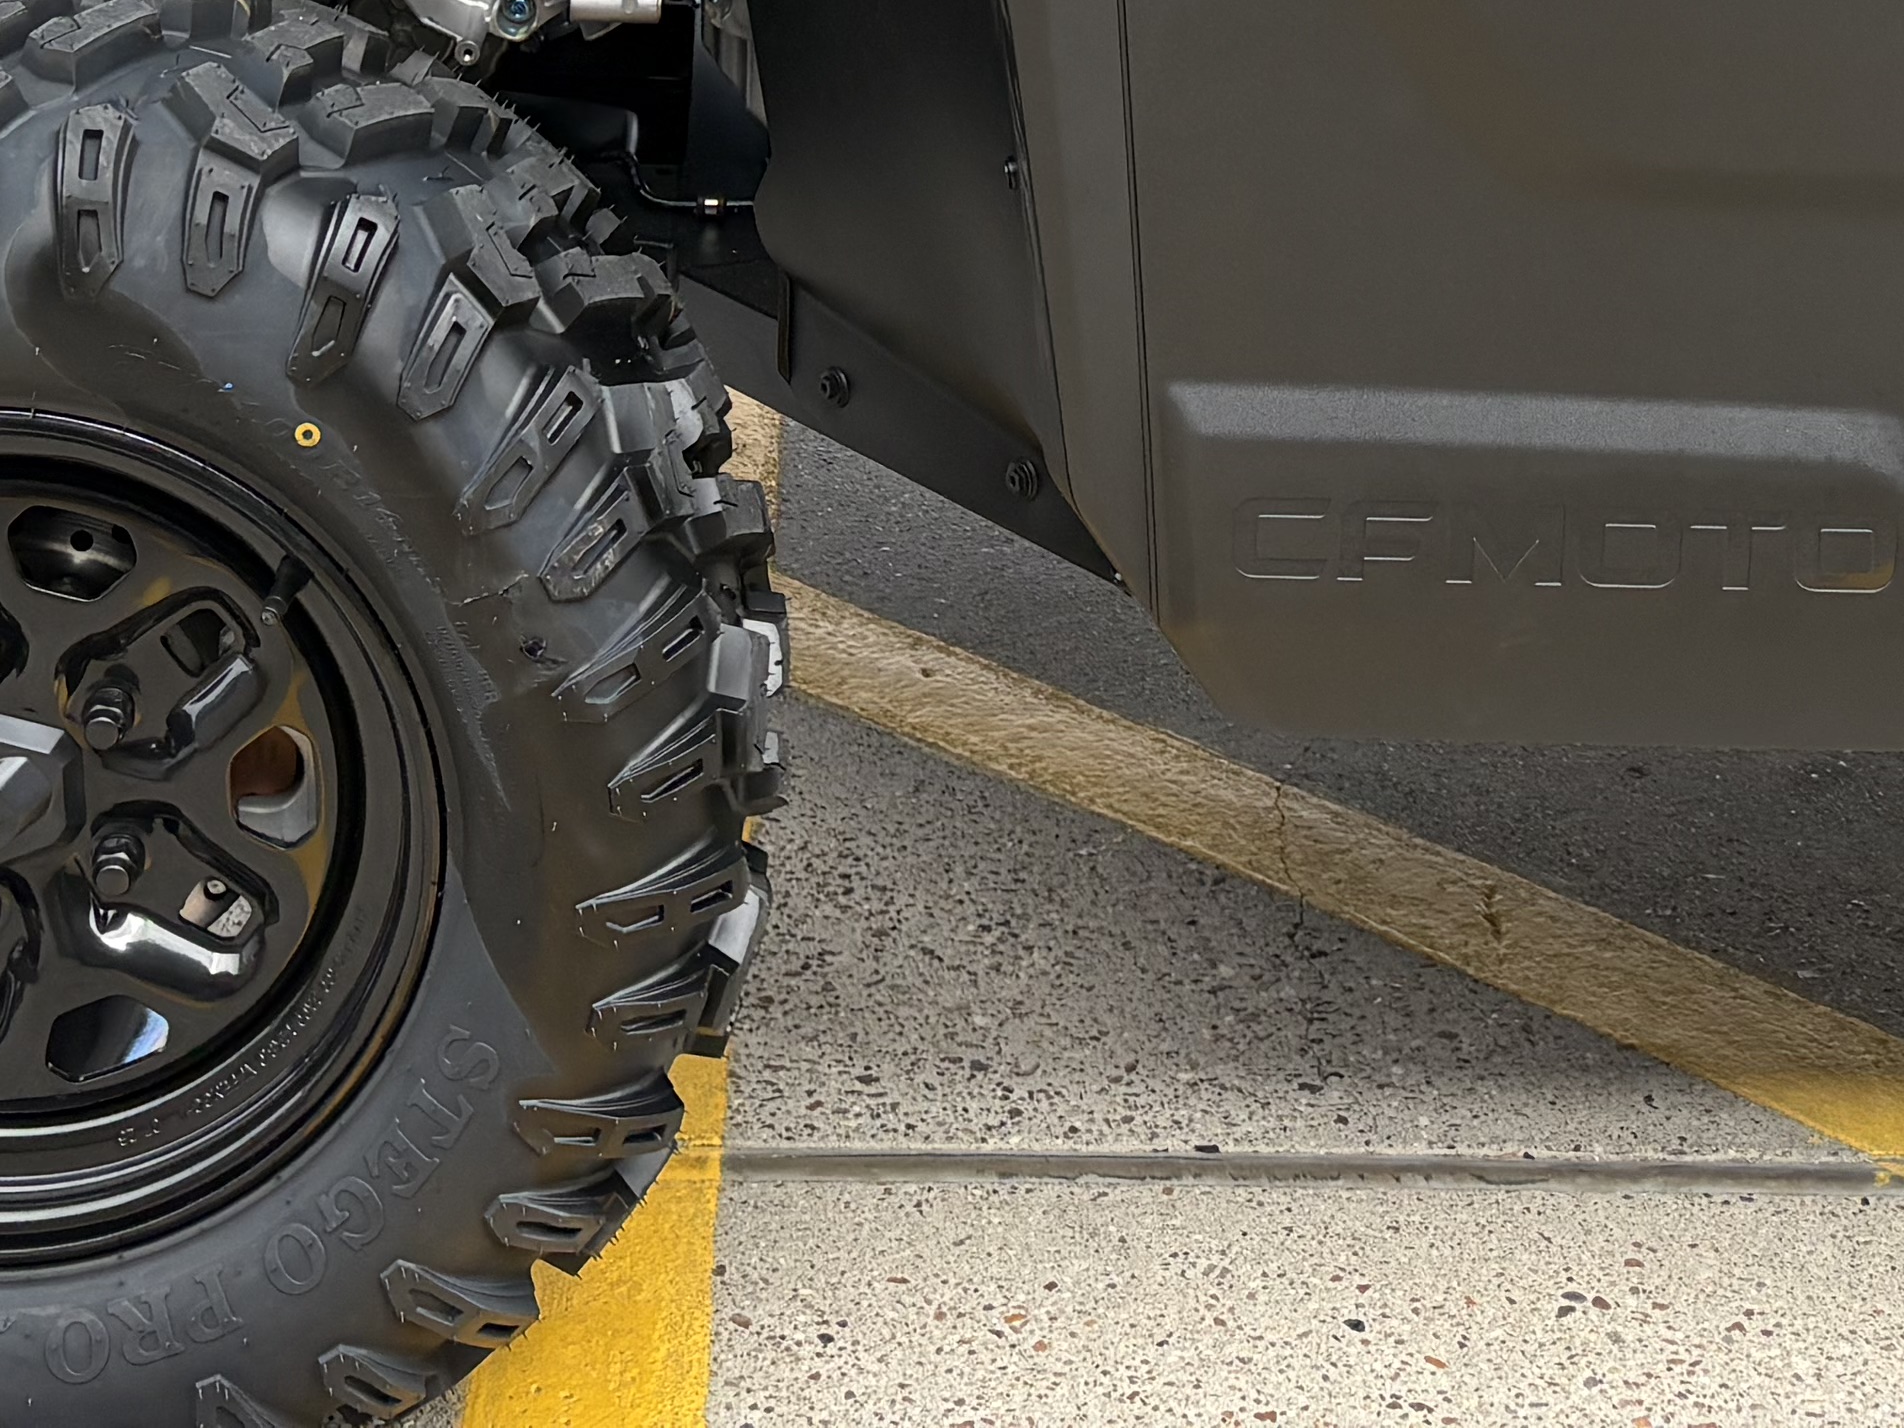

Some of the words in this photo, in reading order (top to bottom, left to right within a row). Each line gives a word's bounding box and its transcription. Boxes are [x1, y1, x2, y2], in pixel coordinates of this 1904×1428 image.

[1233, 496, 1899, 594] CFMOTO
[262, 1023, 500, 1296] STEGO
[45, 1263, 244, 1384] PRO
